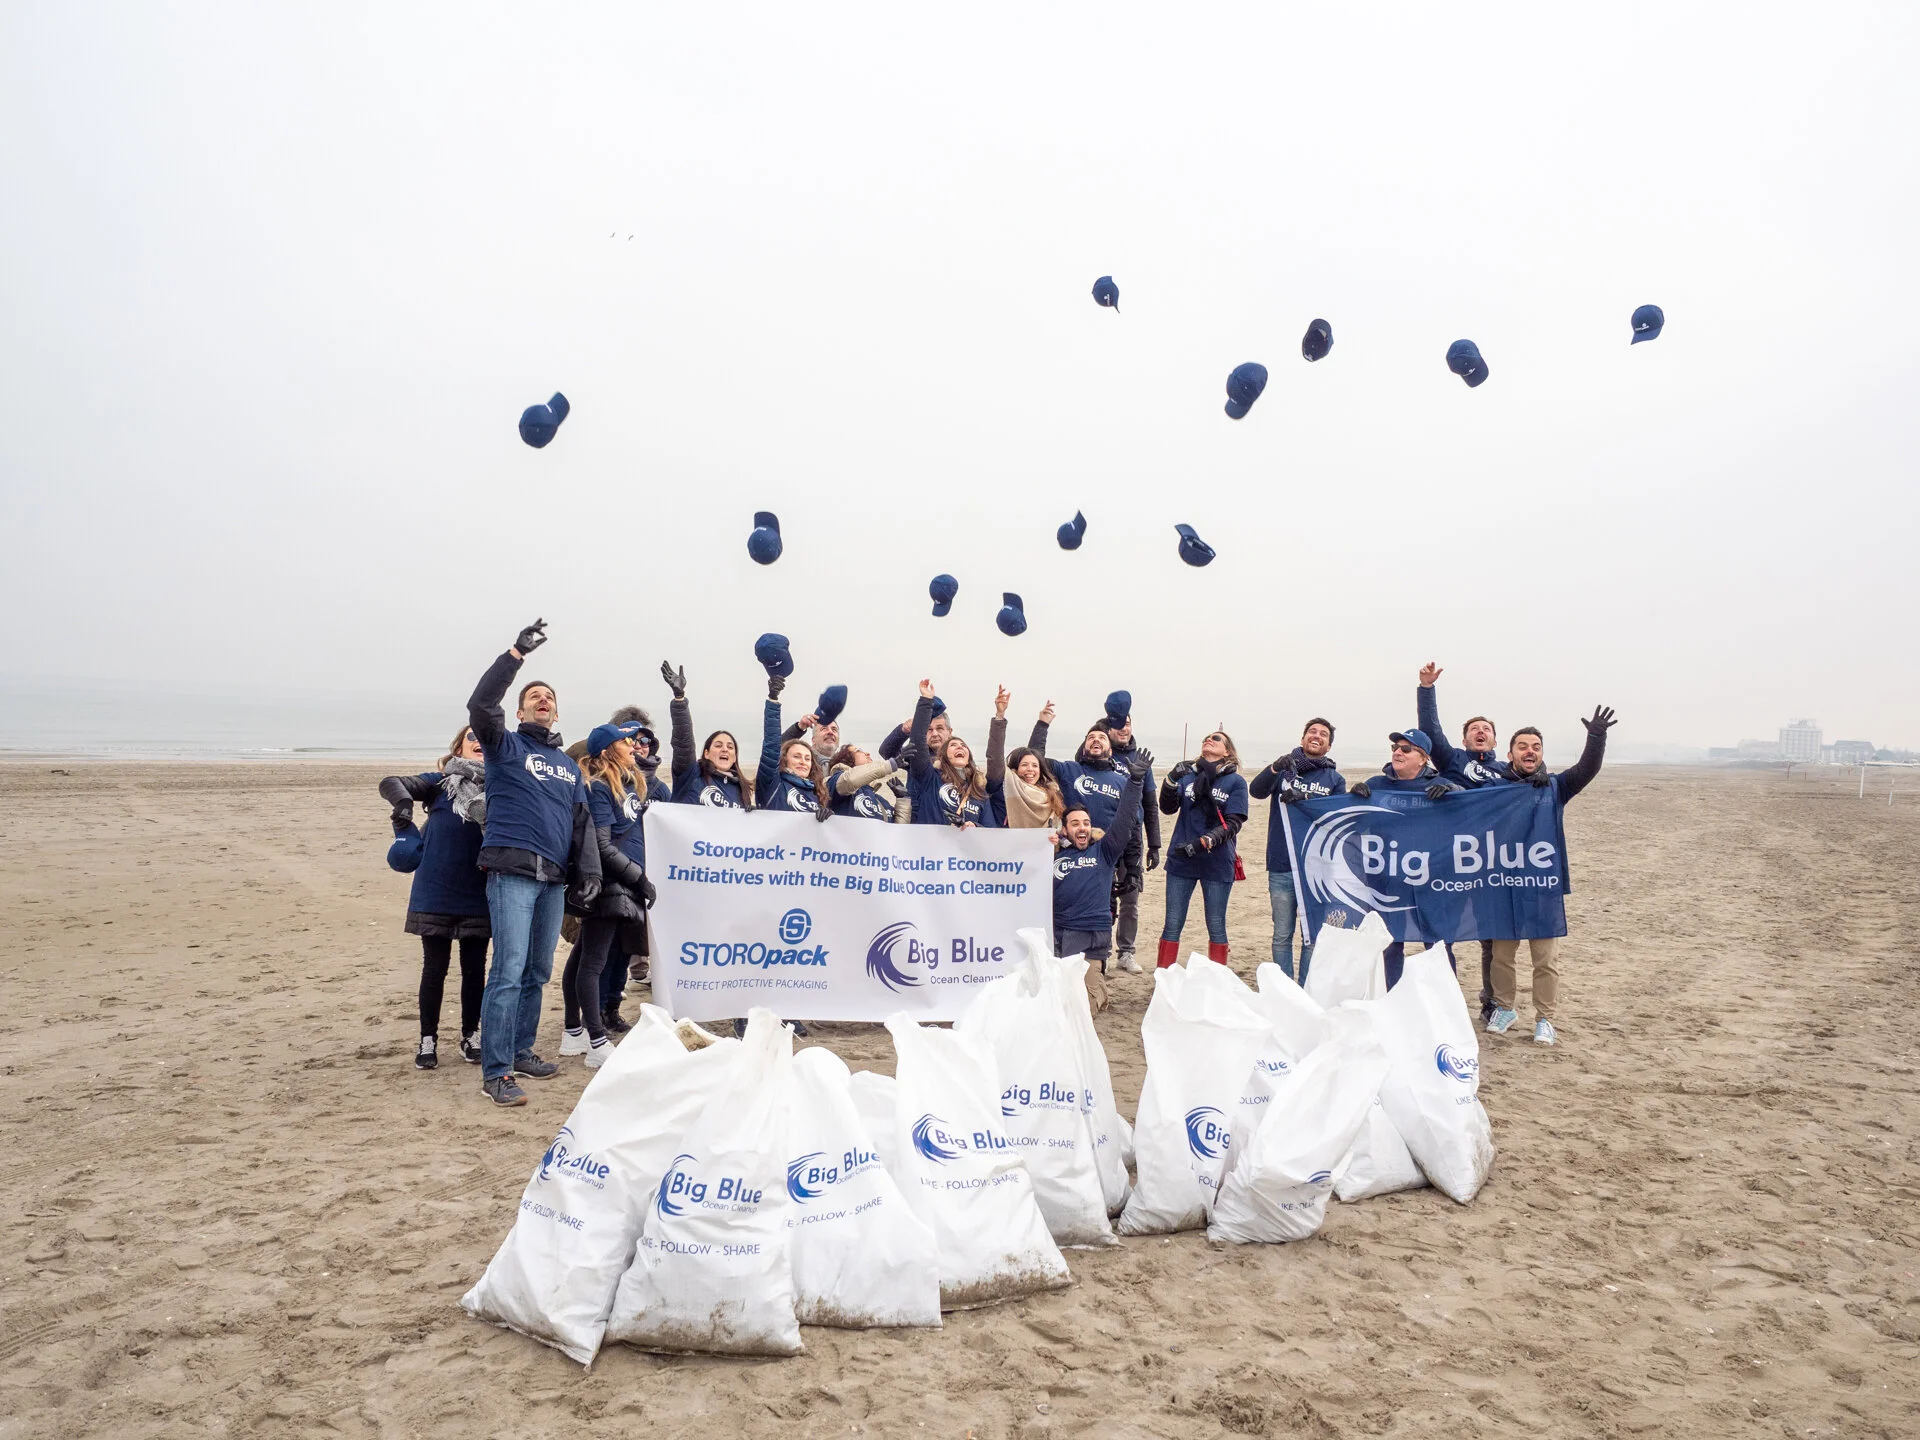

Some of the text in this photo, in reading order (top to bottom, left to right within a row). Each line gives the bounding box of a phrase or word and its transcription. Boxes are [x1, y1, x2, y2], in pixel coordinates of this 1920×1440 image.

[534, 760, 554, 775] Big
[557, 765, 577, 783] Blue
[1084, 779, 1099, 792] Big
[1102, 784, 1120, 796] Blue
[1211, 788, 1229, 799] Blue
[1293, 779, 1308, 793] Big
[1310, 782, 1330, 793] Blue
[714, 791, 730, 808] Big
[692, 840, 786, 862] Storopack
[800, 846, 889, 871] Promoting
[948, 856, 1024, 875] Economy
[1061, 861, 1075, 871] Big
[1360, 830, 1556, 886] Big Blue
[667, 864, 1027, 897] Initiatives with the Big Blue Ocean Cleanup
[1430, 873, 1559, 892] Ocean Cleanup
[679, 941, 830, 969] STOROpack
[907, 936, 1005, 970] Big Blue
[676, 978, 829, 991] PERFECT PROTECTIVE PACKAGING
[930, 975, 960, 985] Ocean
[1039, 1081, 1075, 1103] Blue
[1239, 1095, 1270, 1105] OLLOW
[1455, 1096, 1471, 1105] LIKE
[935, 1128, 1007, 1149] Big Blu
[1007, 1136, 1039, 1147] LLOW
[1048, 1138, 1074, 1150] SHARE
[1205, 1122, 1231, 1149] Big
[808, 1147, 880, 1184] Big Blue
[558, 1165, 605, 1190] Ocean Cleanup
[836, 1171, 855, 1185] Ocean
[946, 1178, 987, 1190] FOLLOW
[991, 1173, 1019, 1187] SHARE
[1198, 1174, 1219, 1190] FOLL
[670, 1172, 762, 1203] Big Blue
[701, 1200, 729, 1211] Ocean
[801, 1210, 847, 1225] FOLLOW
[855, 1196, 883, 1215] SHARE
[1280, 1203, 1294, 1211] IKE
[532, 1203, 556, 1220] FOLLOW
[558, 1212, 584, 1231] SHARE
[660, 1240, 712, 1255] FOLLOW
[723, 1243, 760, 1256] SHARE
